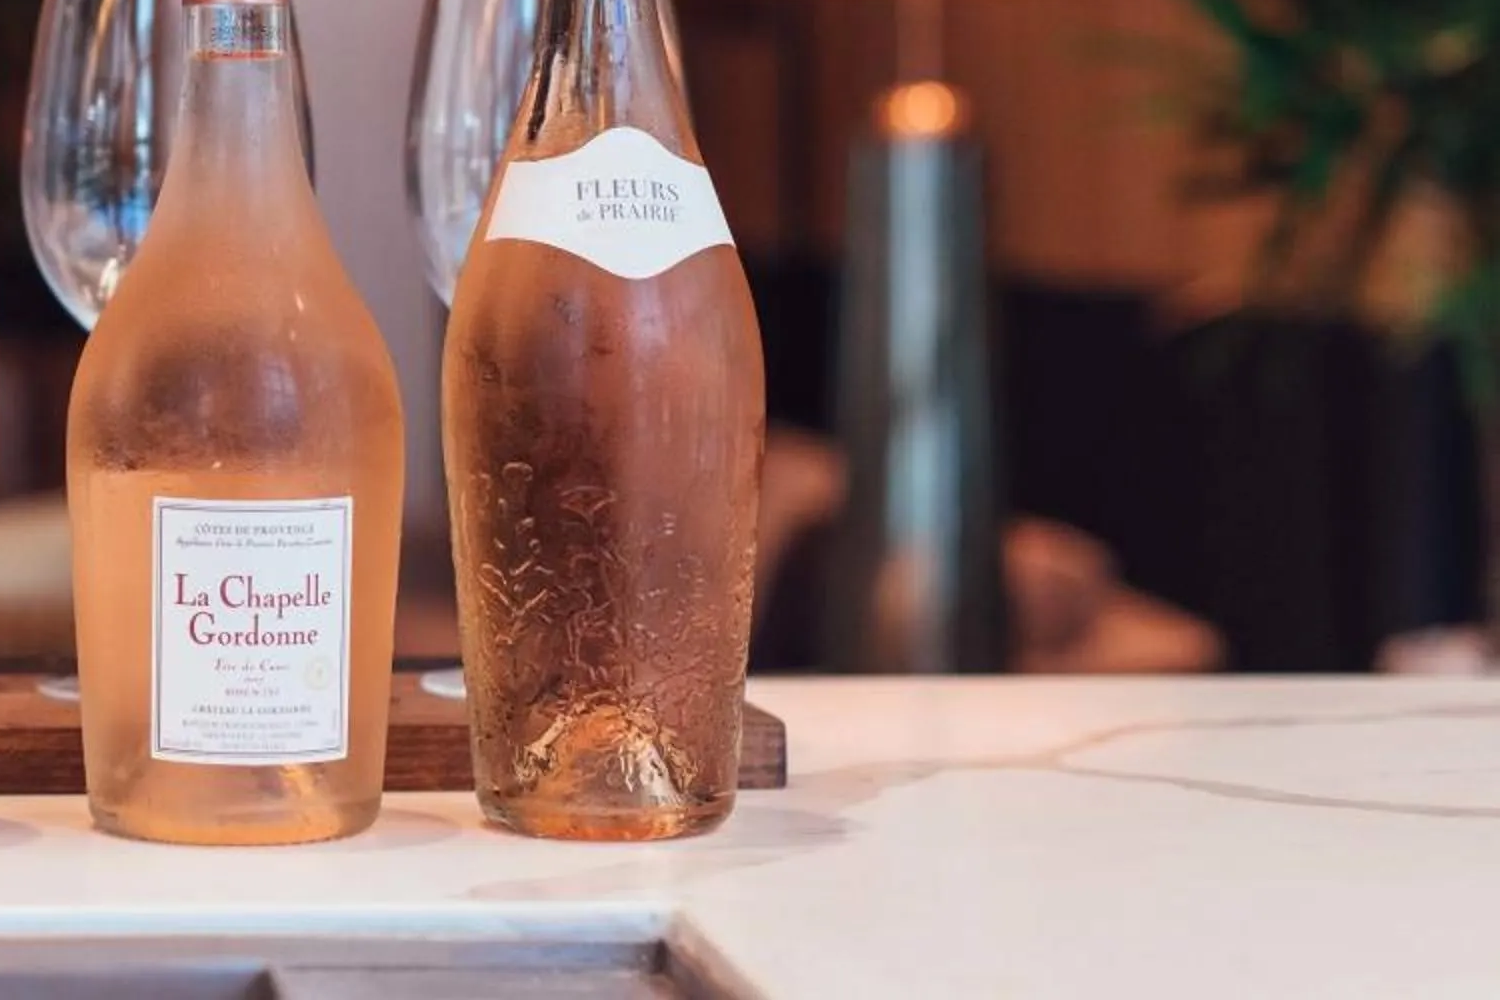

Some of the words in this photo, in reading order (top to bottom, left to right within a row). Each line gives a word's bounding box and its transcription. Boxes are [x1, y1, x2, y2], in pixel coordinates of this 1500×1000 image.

[576, 178, 680, 202] FLEURS
[598, 202, 680, 223] PRAIRIE
[173, 572, 209, 608] La
[219, 572, 332, 619] Chapelle
[188, 611, 319, 647] Gordonne
